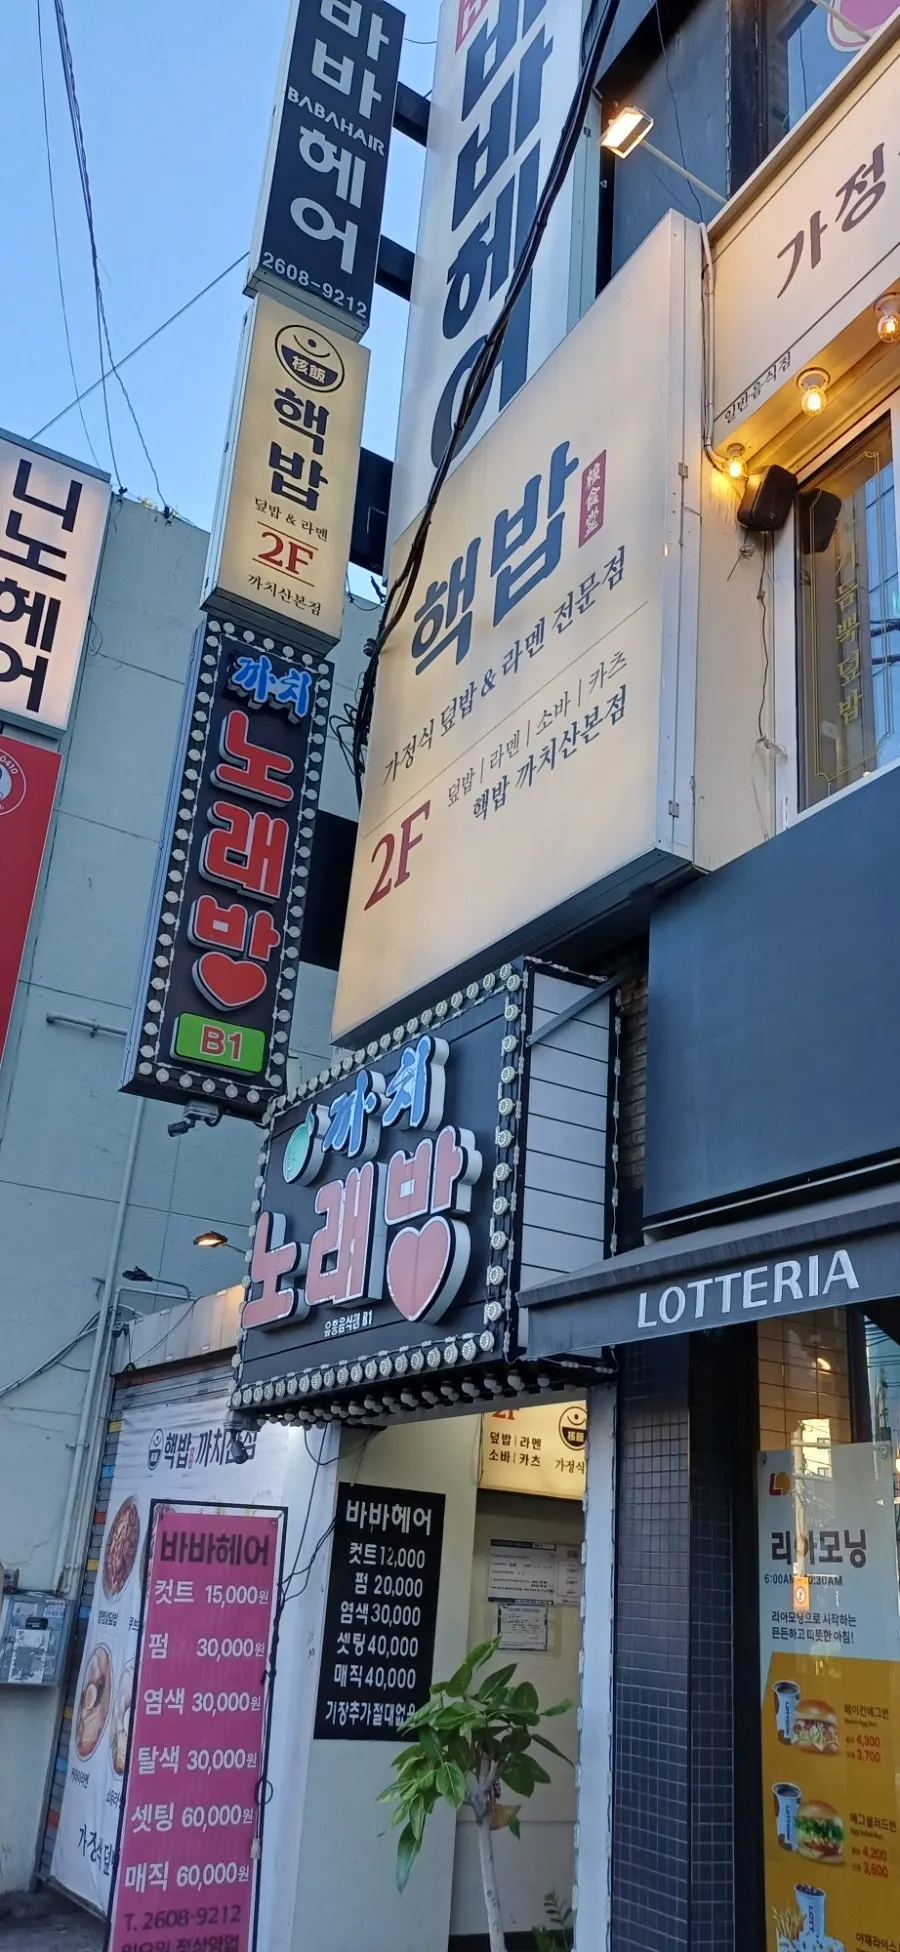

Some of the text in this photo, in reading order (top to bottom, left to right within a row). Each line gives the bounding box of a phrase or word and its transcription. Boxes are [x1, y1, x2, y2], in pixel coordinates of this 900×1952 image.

[776, 142, 900, 300] 가정
[262, 252, 368, 319] 2608-9212
[268, 387, 329, 512] 핵밥
[255, 497, 328, 542] 덮밥 & 라멘
[258, 531, 314, 575] 2F
[411, 440, 580, 676] 핵밥
[247, 574, 322, 617] 까치산본점
[382, 545, 625, 786] 가정식 덮밥 & 라멘 전문점
[231, 653, 312, 719] 까치
[447, 650, 628, 808] 덮밥 라멘 소바 카츠
[472, 683, 627, 821] 핵밥 까치산본점
[363, 799, 432, 912] 2F
[200, 1026, 243, 1063] B1
[322, 1034, 440, 1159] 까치
[637, 1248, 860, 1329] LOTTERIA
[362, 1309, 373, 1327] B1
[165, 1432, 191, 1469] 핵밥
[490, 1431, 541, 1451] 덮밥 라멘
[488, 1449, 540, 1467] 소바 카츠
[554, 1457, 584, 1474] 가정식
[346, 1500, 432, 1536] 바바헤어
[160, 1531, 269, 1567] 바바헤어
[349, 1542, 425, 1569] 컷트 12,000
[771, 1529, 867, 1568] 리아모닝
[154, 1579, 269, 1608] 컷트 15,000원
[355, 1572, 423, 1598] 펌 20,000
[804, 1575, 843, 1586] 0:30AM
[341, 1601, 421, 1627] 염색 30,000
[772, 1611, 857, 1627] 리아모닝으로 시작하는
[149, 1632, 265, 1662] 펌 30,000원
[337, 1632, 418, 1658] 셋팅 40,000
[772, 1627, 805, 1640] 든든하고
[334, 1664, 416, 1690] 매직 40,000
[143, 1687, 261, 1717] 염색 30,000원
[856, 1734, 880, 1748] 4,300
[857, 1748, 880, 1762] 3,700
[137, 1745, 257, 1775] 탈색 30,000원
[131, 1803, 254, 1833] 셋팅 60,000원
[124, 1860, 250, 1893] 매직 60,000원
[124, 1904, 242, 1932] T. 2608-9212
